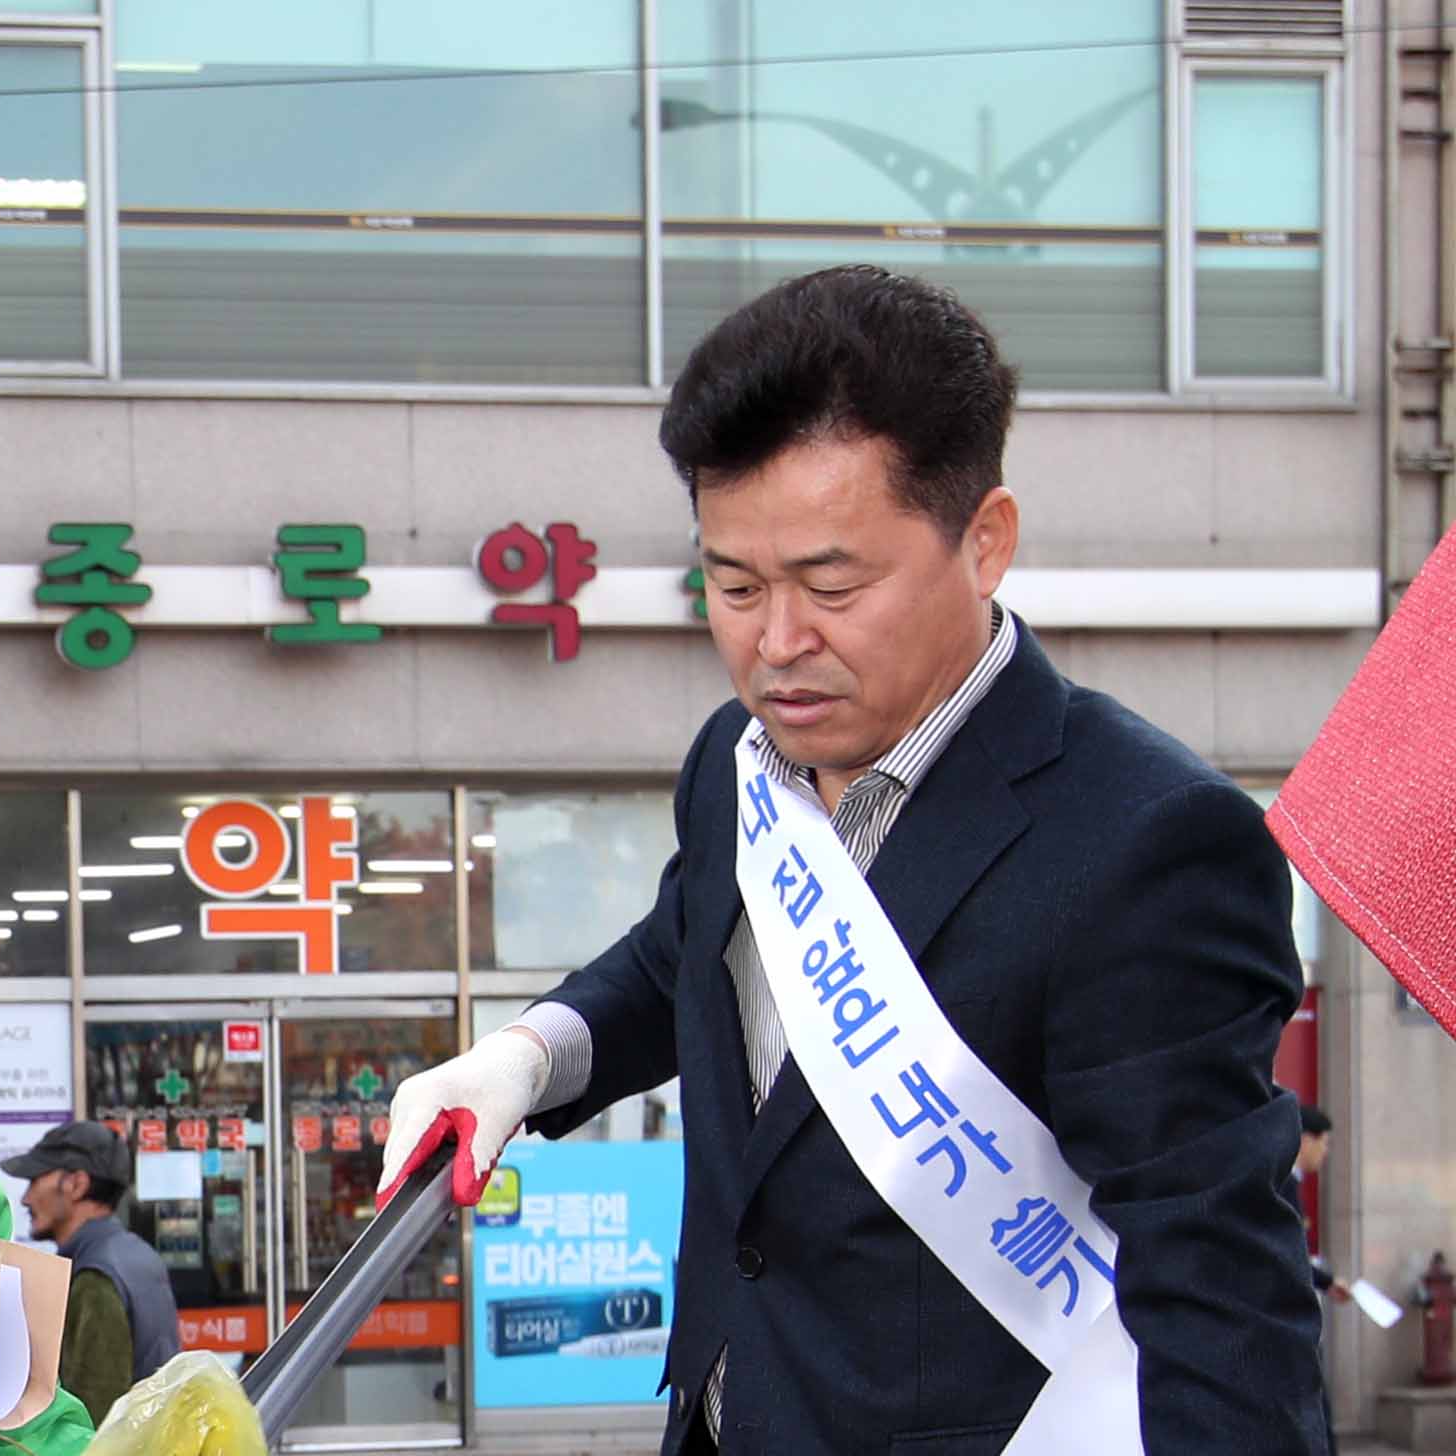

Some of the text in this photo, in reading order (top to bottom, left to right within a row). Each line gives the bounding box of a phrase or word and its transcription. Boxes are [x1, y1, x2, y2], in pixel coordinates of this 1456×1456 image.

[34, 522, 708, 670] 종로약
[180, 796, 359, 976] 약
[740, 772, 1117, 1318] 내 집 앞은 내가 쓸기
[484, 1240, 666, 1286] 티어실원스
[521, 1193, 628, 1239] 무좀엔
